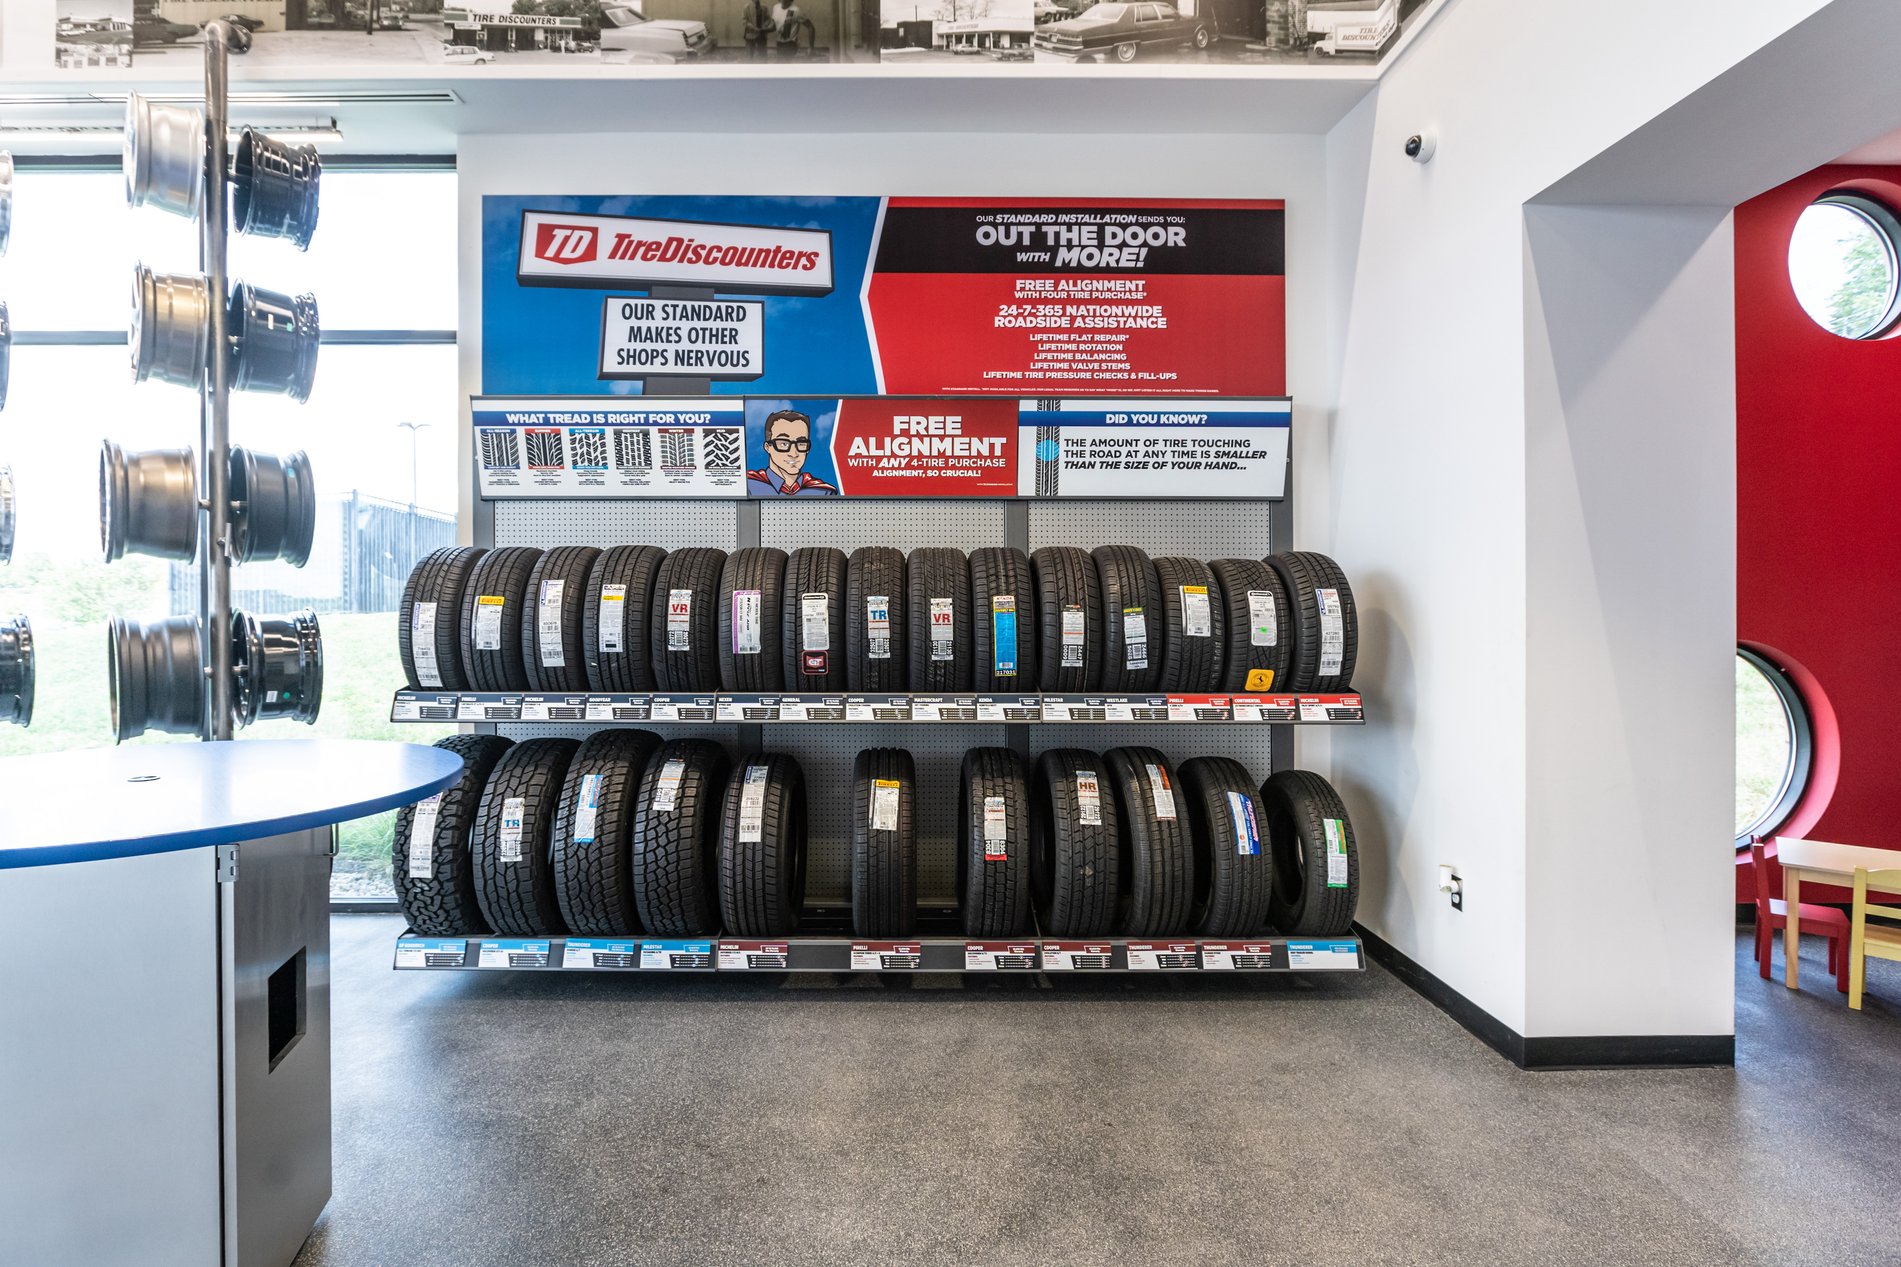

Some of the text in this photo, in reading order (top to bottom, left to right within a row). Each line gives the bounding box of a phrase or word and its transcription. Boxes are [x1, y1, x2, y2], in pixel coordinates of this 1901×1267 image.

[472, 14, 556, 25] TIRE DISCOUNTERS
[996, 214, 1056, 222] STANDARD
[1058, 214, 1136, 224] INSTALLATION
[976, 225, 1186, 247] OUT THE DOOR
[544, 228, 819, 271] TD TireDiscounters
[1016, 247, 1148, 268] WITH MORE!
[1016, 280, 1145, 292] FREE ALIGNMENT
[622, 303, 746, 322] OUR STANDARD
[999, 305, 1162, 317] 24-7-365 NATIONWIDE
[994, 316, 1167, 328] ROADSIDE ASSISTANCE
[628, 326, 738, 345] MAKES OTHER
[616, 348, 750, 368] SHOPS NERVOUS
[506, 414, 711, 424] WHAT TREAD IS RIGHT FOR YOU?
[1106, 414, 1208, 424] DID YOU KNOW?
[893, 416, 962, 435] FREE
[848, 437, 1006, 456] ALIGNMENT
[1064, 439, 1250, 447] THE AMOUNT OF TIRE TOUCHING
[1064, 450, 1267, 458] THE ROAD AT ANY TIME IS SMALLER
[848, 458, 1006, 468] WITH ANY 4-TIRE PURCHASE
[1064, 461, 1247, 470] THAN THE SIZE OF YOUR HAND...
[672, 604, 688, 613] VR
[871, 610, 886, 620] TR
[933, 614, 950, 622] VR
[1079, 782, 1096, 790] HR
